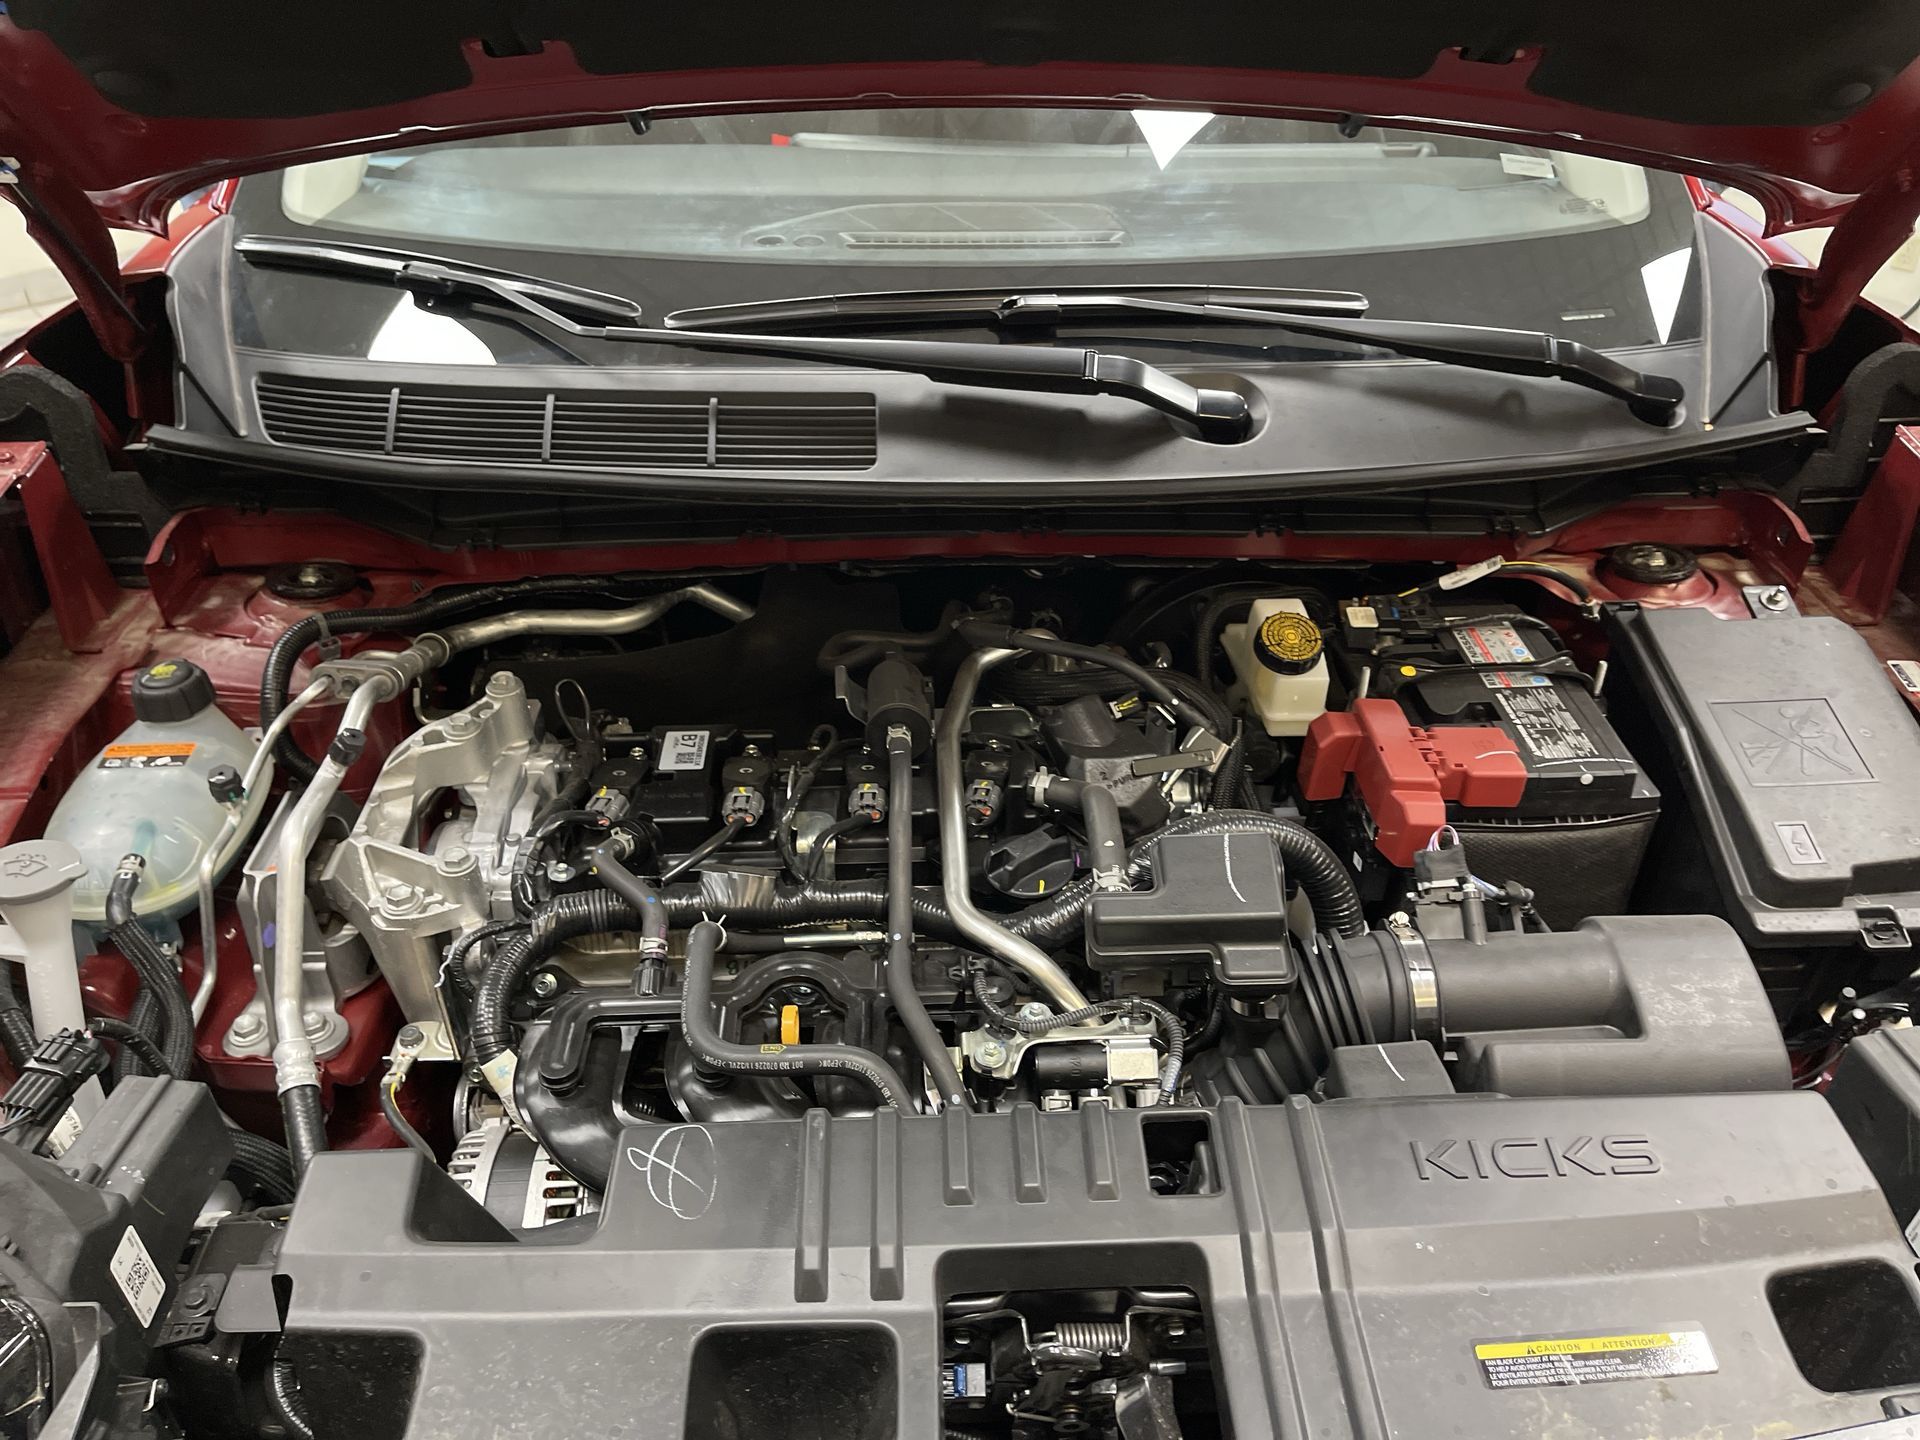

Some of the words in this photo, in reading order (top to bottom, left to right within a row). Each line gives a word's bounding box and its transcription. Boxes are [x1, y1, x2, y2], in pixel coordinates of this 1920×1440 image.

[1456, 630, 1480, 659] NISSAN
[681, 734, 698, 748] B7
[1409, 1135, 1661, 1180] KICKS
[1536, 1343, 1581, 1354] CAUTION
[1602, 1338, 1655, 1349] ATTENTION
[1496, 1364, 1510, 1372] HELP
[1510, 1363, 1527, 1371] AVOID
[1527, 1361, 1555, 1370] PERSONAL
[1497, 1370, 1535, 1379] VENTILATEUR
[1601, 1364, 1617, 1372] TOUT
[1492, 1379, 1510, 1387] POUR
[1529, 1376, 1549, 1385] TOUTE
